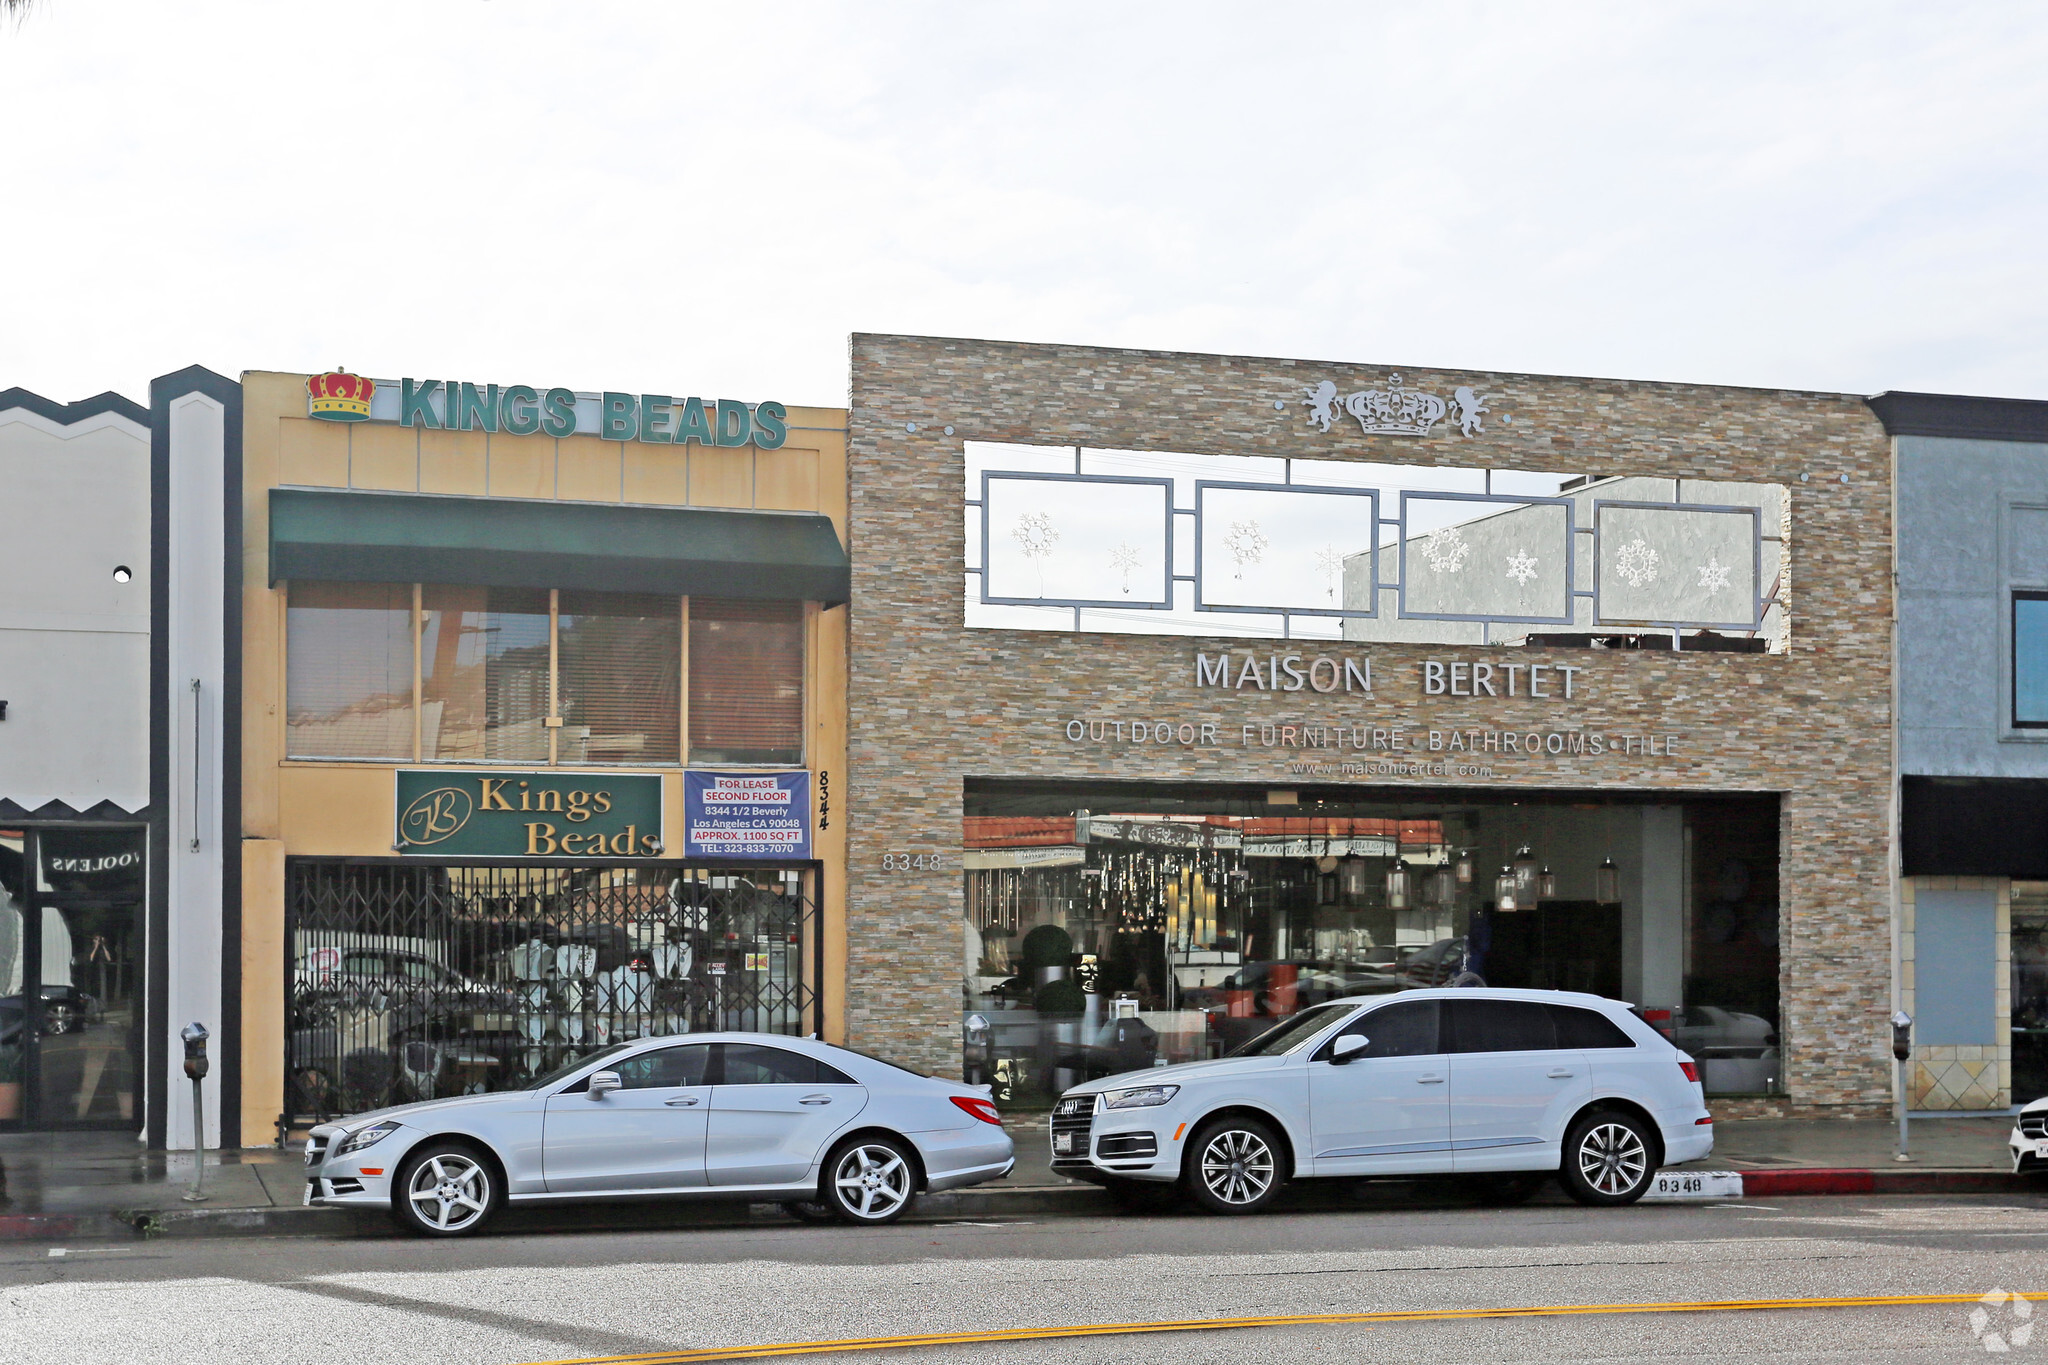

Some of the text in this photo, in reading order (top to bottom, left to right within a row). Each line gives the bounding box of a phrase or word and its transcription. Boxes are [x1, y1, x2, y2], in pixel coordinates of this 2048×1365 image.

[400, 377, 788, 450] KINGS BEADS
[1196, 653, 1582, 699] MAISON BERTET
[1066, 720, 1680, 756] OUTDOOR FURNITURE BATHROOMS TILE
[719, 780, 775, 789] FOR LEASE
[477, 778, 612, 822] Kings
[705, 791, 787, 801] SECOND FLOOR
[818, 770, 829, 830] 8344
[705, 806, 789, 818] 8344 1/2 Beverly
[693, 819, 800, 830] Los Angeles CA 90048
[524, 822, 661, 856] Beads
[694, 831, 800, 842] APPROX. 1100 SQ FT
[700, 843, 794, 854] TEL: 323-833-7070
[882, 853, 941, 871] 8348
[1658, 1178, 1702, 1193] 8348
